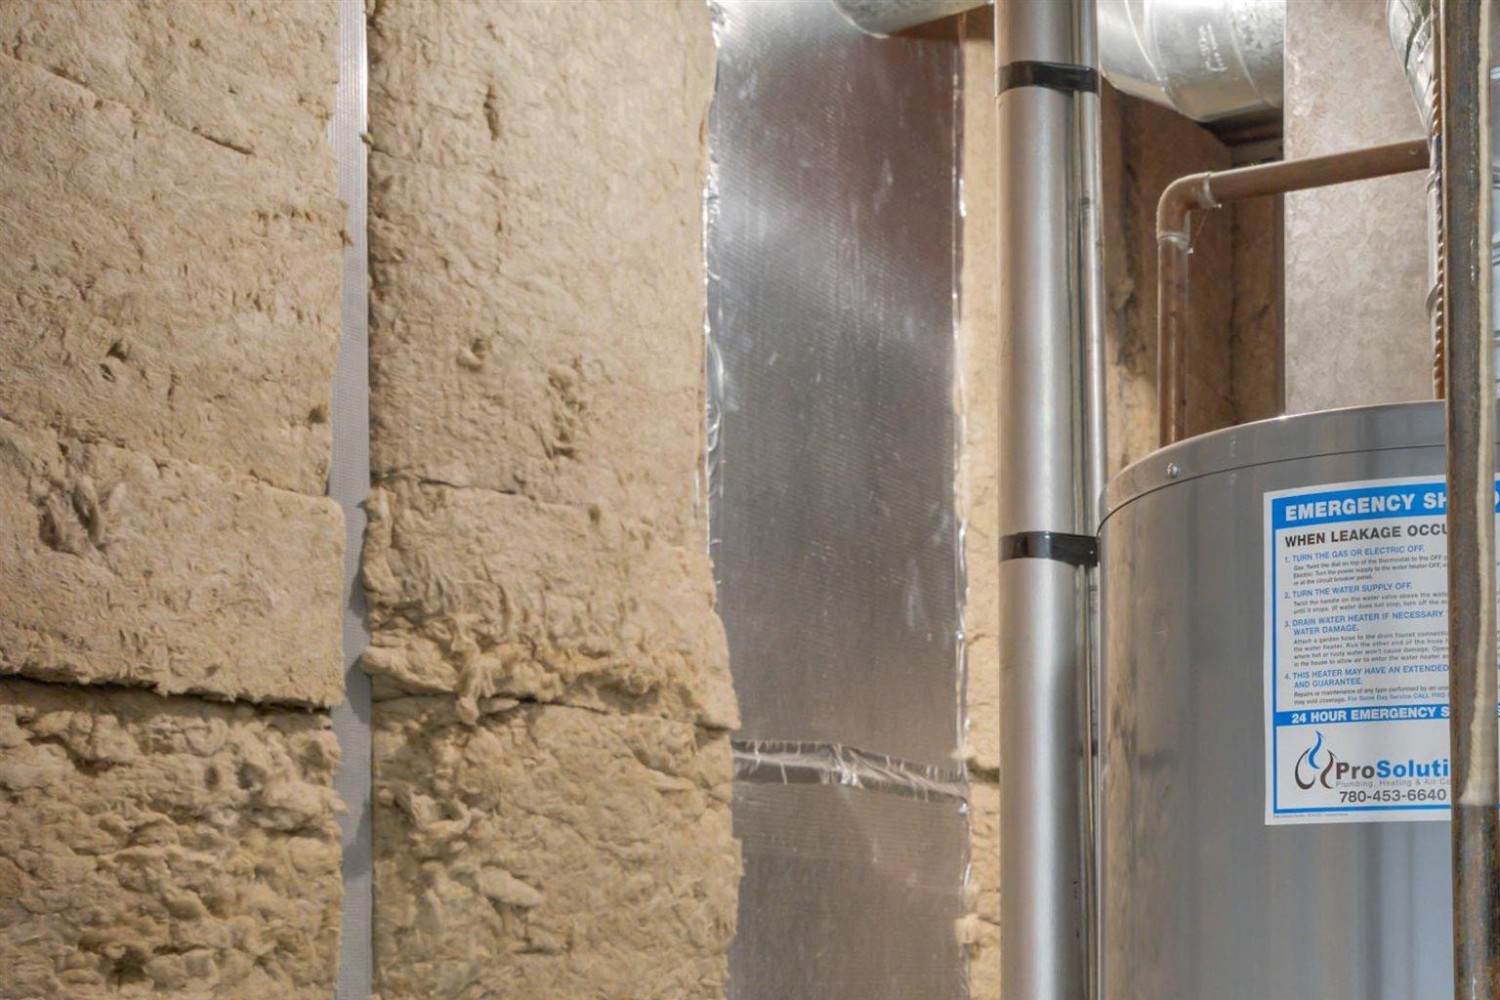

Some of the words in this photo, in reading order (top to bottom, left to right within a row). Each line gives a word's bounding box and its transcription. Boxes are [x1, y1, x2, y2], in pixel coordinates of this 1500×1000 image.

[1285, 493, 1415, 522] EMERGENCY
[1285, 532, 1326, 548] WHEN
[1330, 526, 1402, 543] LEAKAGE
[1315, 552, 1330, 560] THE
[1350, 549, 1362, 557] OR
[1364, 546, 1405, 556] ELECTRIC
[1332, 586, 1360, 594] WATER
[1362, 583, 1393, 592] SUPPLY
[1292, 618, 1317, 627] DRAIN
[1318, 616, 1346, 624] WATER
[1348, 613, 1380, 622] HEATER
[1392, 610, 1445, 620] NECESSARY
[1293, 628, 1320, 636] WATER
[1293, 671, 1310, 679] THIS
[1311, 669, 1342, 678] HEATER
[1345, 668, 1362, 676] MAY
[1364, 666, 1386, 674] HAVE
[1388, 666, 1400, 674] AN
[1403, 664, 1449, 673] EXTENDED
[1294, 680, 1310, 689] AND
[1291, 714, 1306, 724] 24
[1310, 711, 1347, 723] HOUR
[1350, 706, 1436, 721] EMERGENCY
[1336, 759, 1449, 780] ProSoluti
[1379, 779, 1412, 787] Heating
[1339, 788, 1447, 803] 780-453-6640
